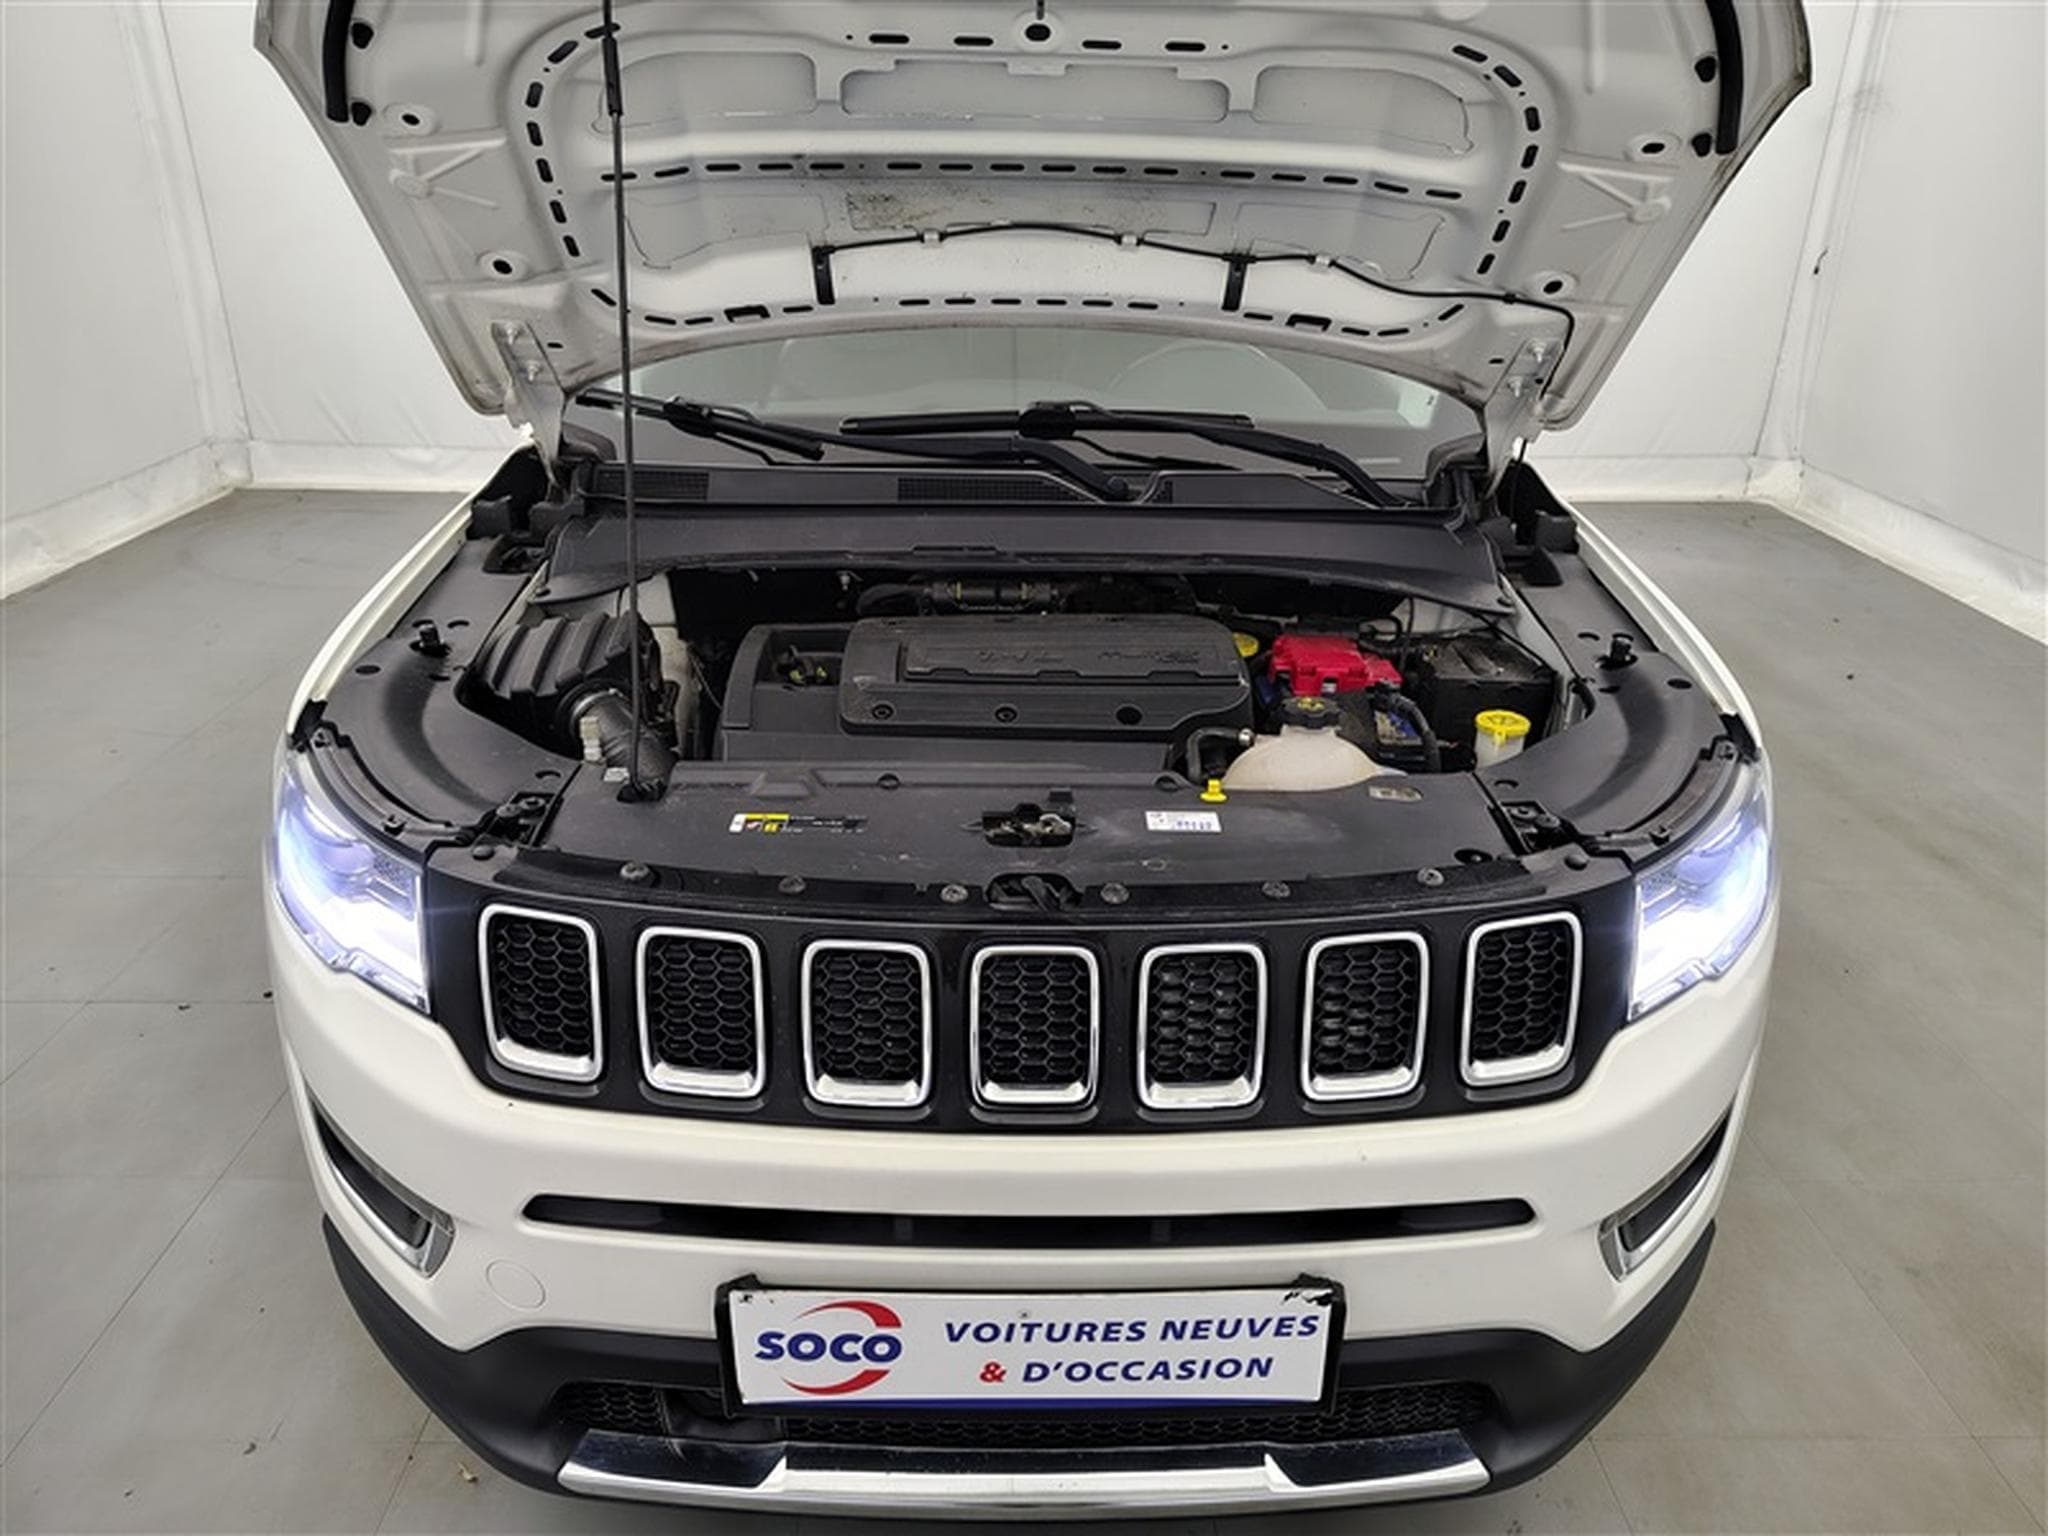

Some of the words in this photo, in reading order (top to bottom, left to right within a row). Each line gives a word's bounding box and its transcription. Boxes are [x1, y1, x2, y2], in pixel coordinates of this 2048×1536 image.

[944, 1319, 1146, 1344] VOITURES
[1160, 1315, 1319, 1341] NEUVES
[755, 1332, 902, 1363] SOCO
[979, 1362, 1007, 1383] &
[1022, 1357, 1274, 1383] D'OCCASION
